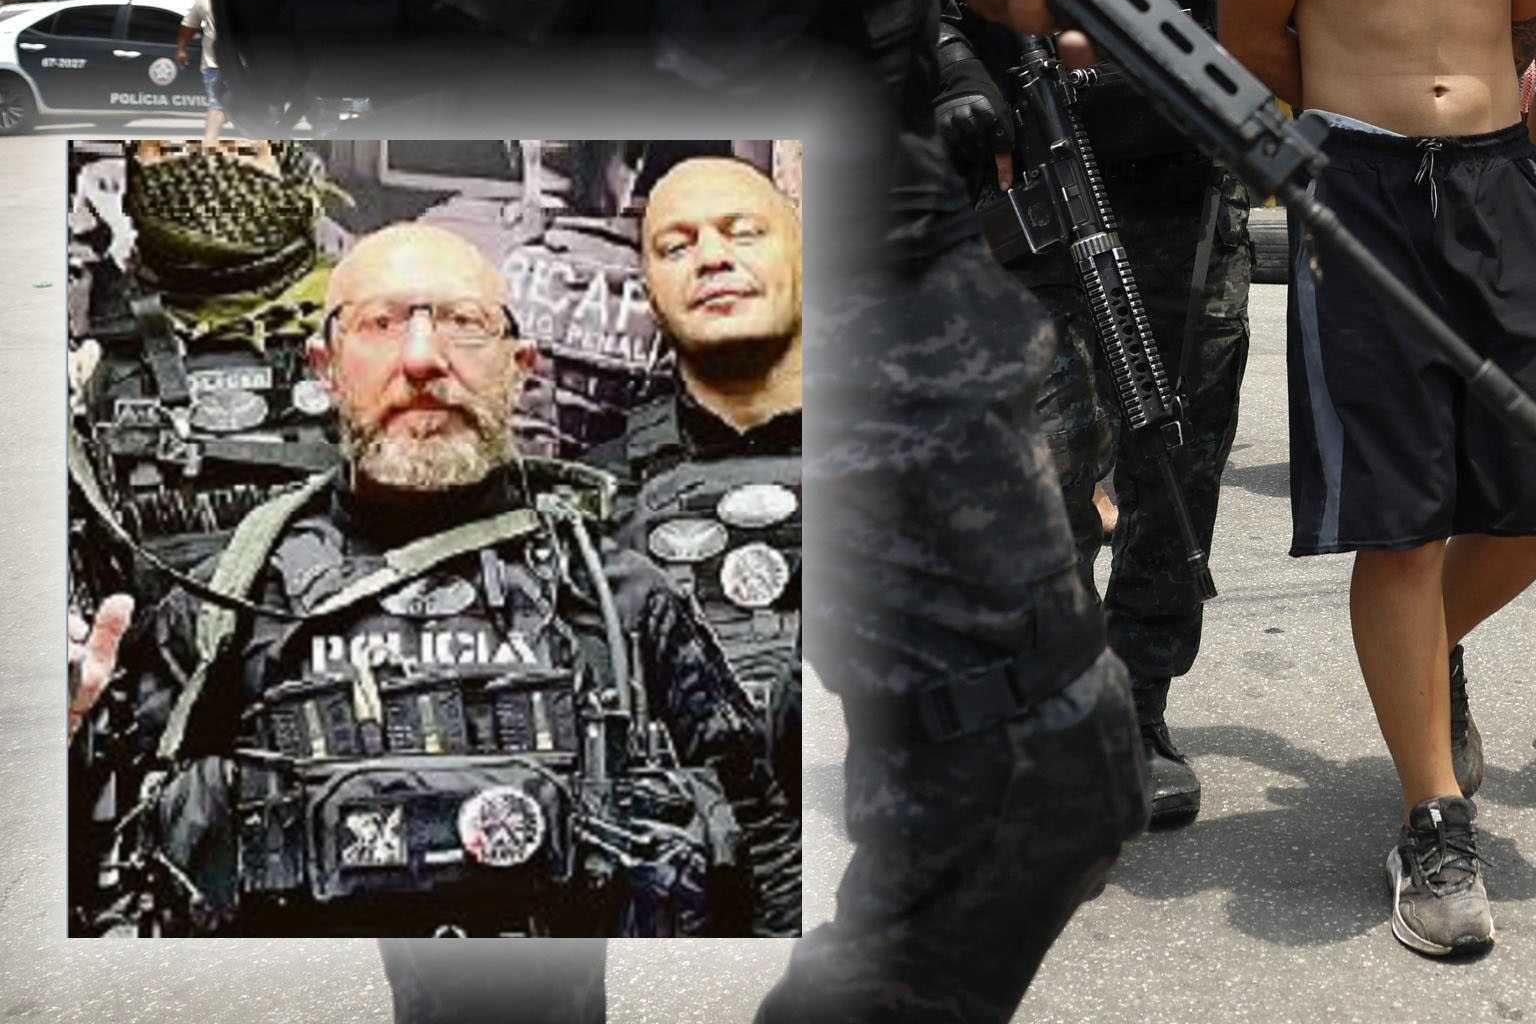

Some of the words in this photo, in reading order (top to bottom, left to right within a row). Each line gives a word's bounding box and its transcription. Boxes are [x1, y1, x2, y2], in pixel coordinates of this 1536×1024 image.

[110, 91, 168, 106] POLÍCIA
[171, 94, 210, 107] CIVIL
[312, 629, 538, 673] POLICIA
